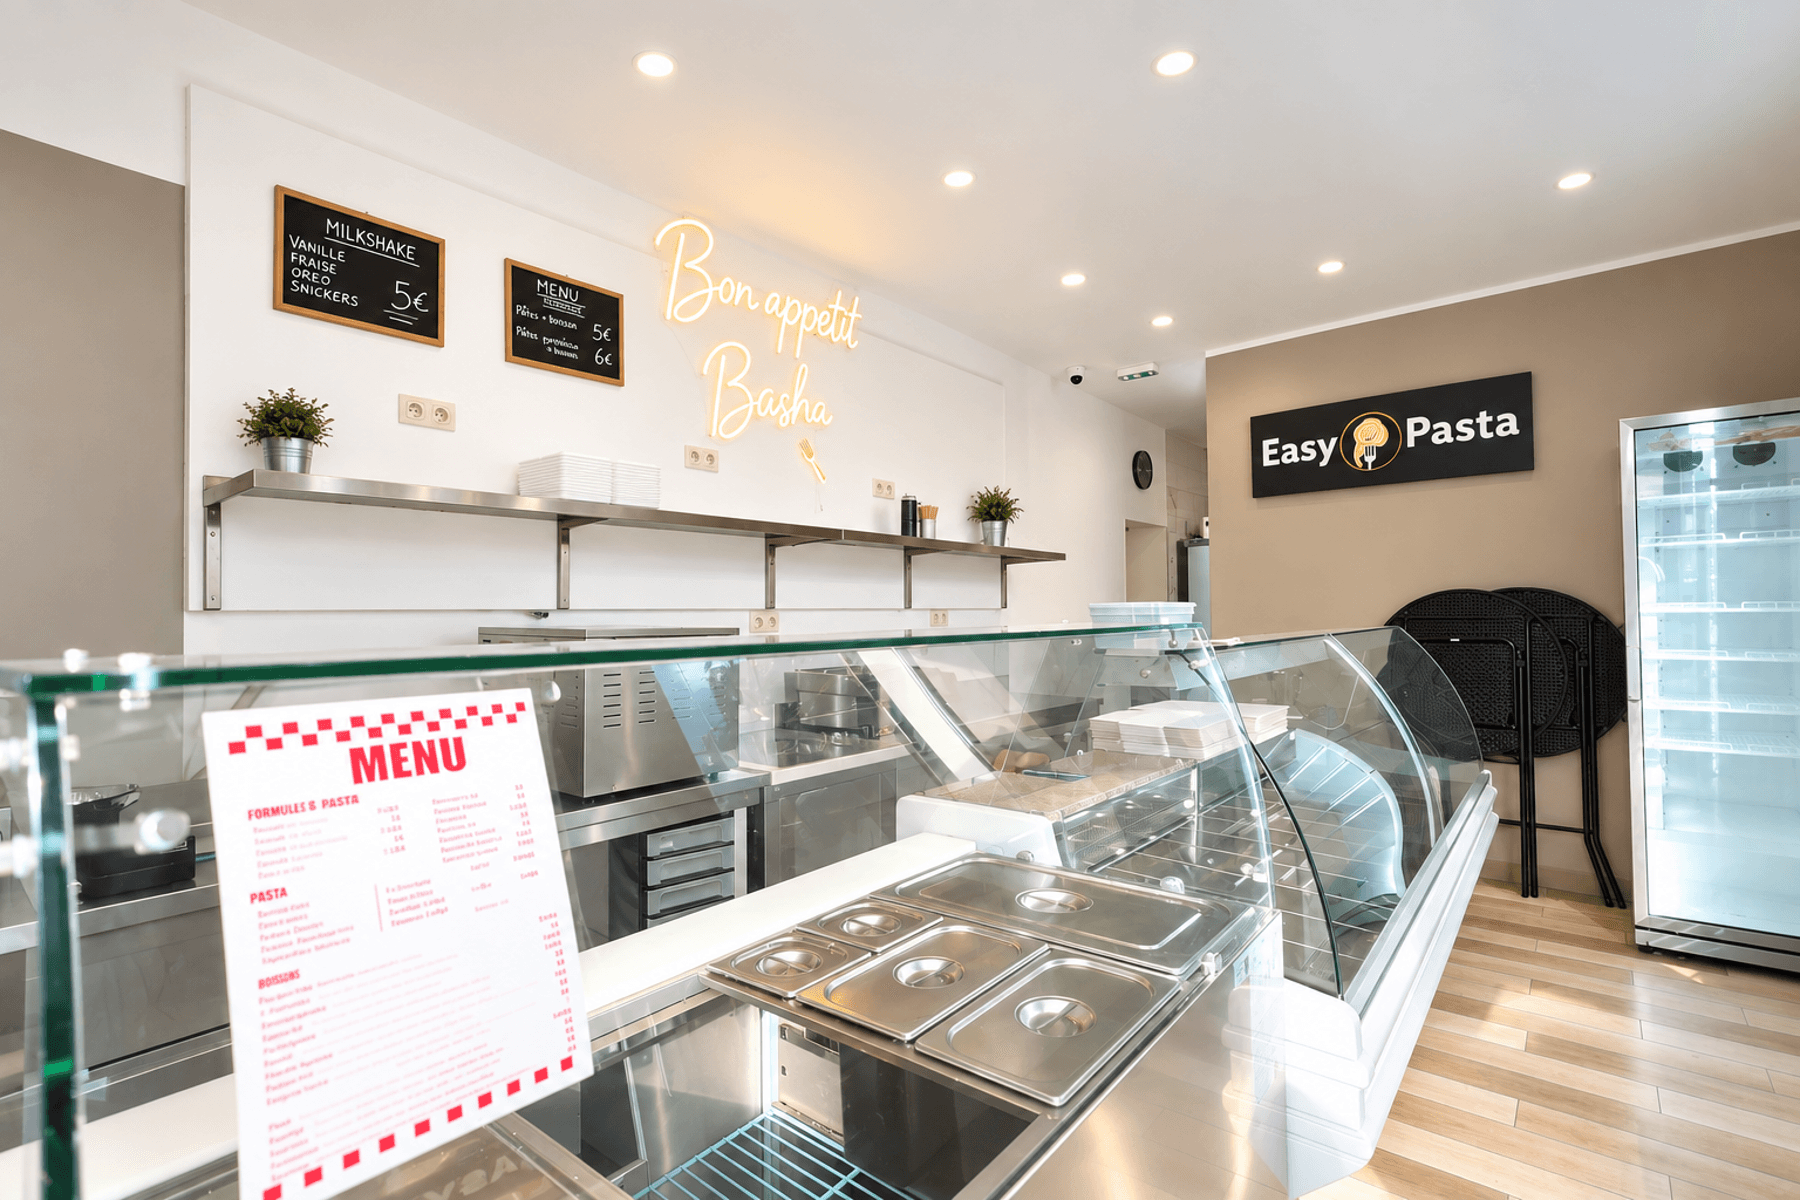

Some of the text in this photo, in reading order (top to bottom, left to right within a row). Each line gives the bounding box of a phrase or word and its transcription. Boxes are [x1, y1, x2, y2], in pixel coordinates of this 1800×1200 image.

[289, 234, 346, 262] VANILLE
[325, 218, 416, 262] MILKSHAKE
[290, 252, 338, 276] FRAISE
[291, 268, 332, 286] OREO
[290, 280, 359, 307] SNICKERS
[391, 281, 429, 313] 5€
[537, 279, 579, 302] MENU
[655, 218, 862, 359] Bon appetit
[592, 323, 612, 342] 5€
[594, 348, 613, 366] 6€
[702, 340, 833, 440] Basha
[1262, 409, 1520, 467] Easy Pasta
[349, 736, 467, 785] MENU
[247, 802, 306, 821] FORMULES
[321, 794, 360, 809] PASTA
[250, 887, 288, 905] PASTA
